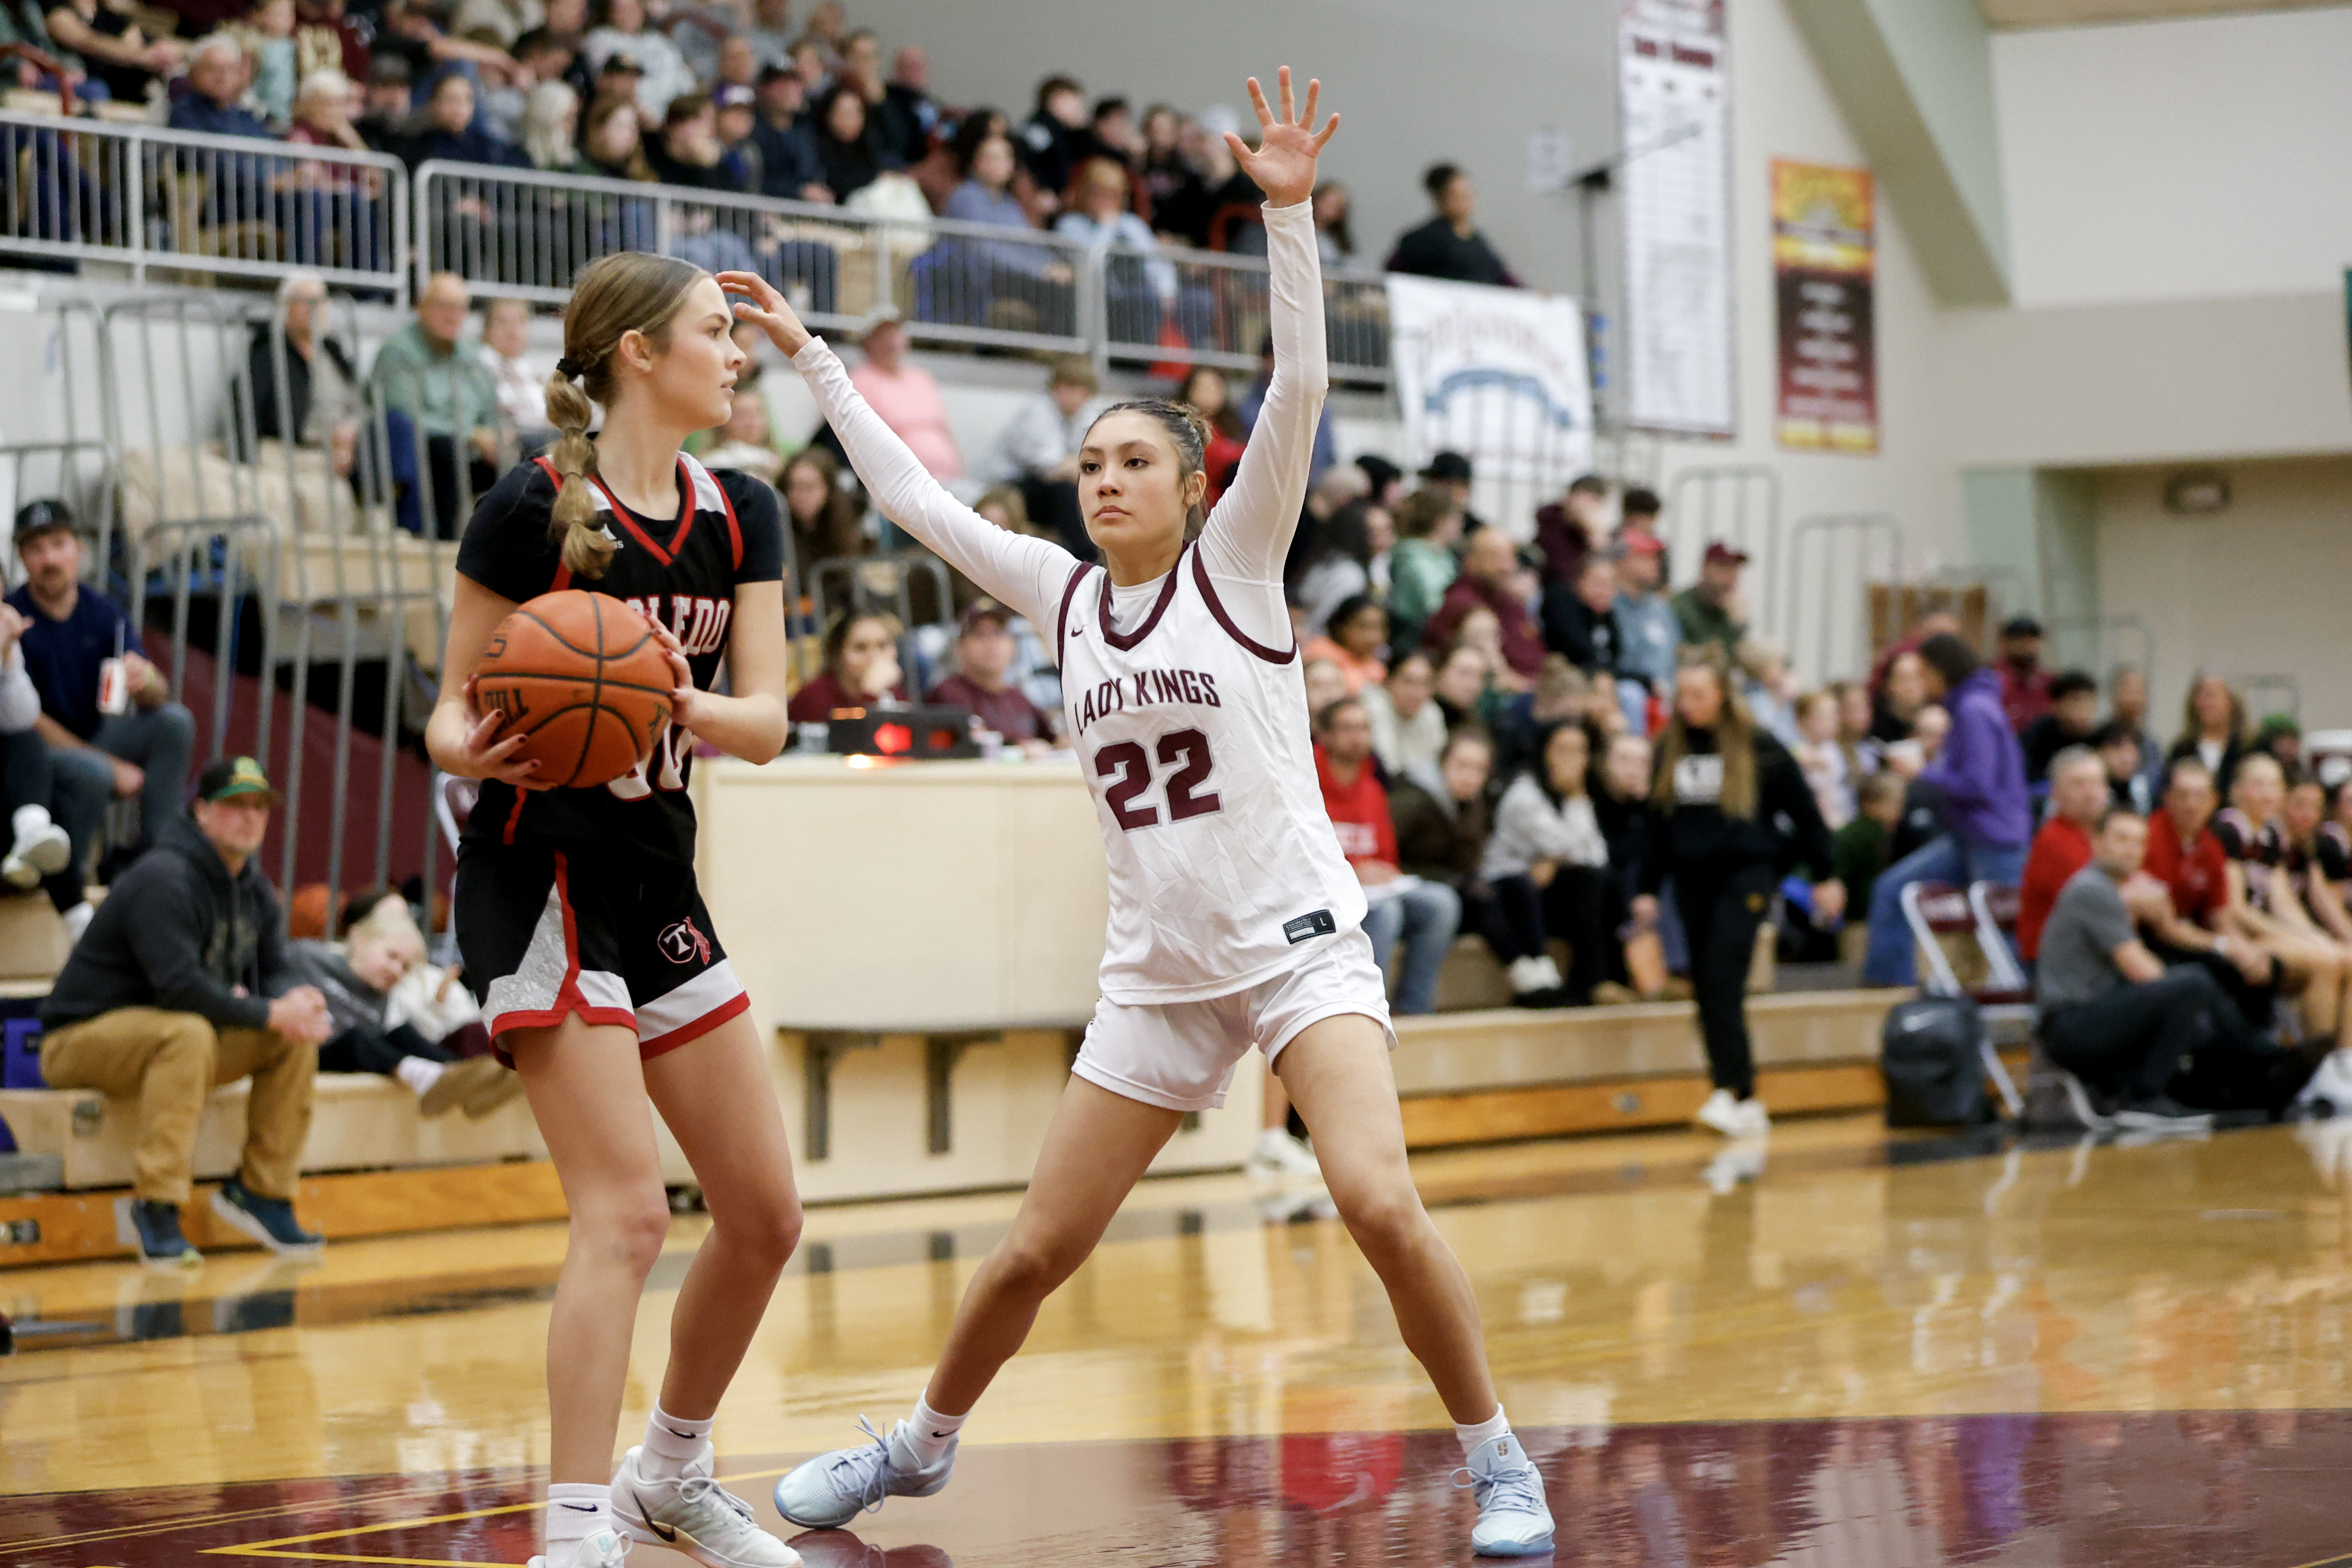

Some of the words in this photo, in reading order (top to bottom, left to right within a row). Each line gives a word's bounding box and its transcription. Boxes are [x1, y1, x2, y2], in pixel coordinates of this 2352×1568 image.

[1074, 677, 1123, 738] LADY
[1133, 668, 1221, 708] KINGS
[1092, 726, 1224, 834] 22
[1319, 917, 1327, 926] L
